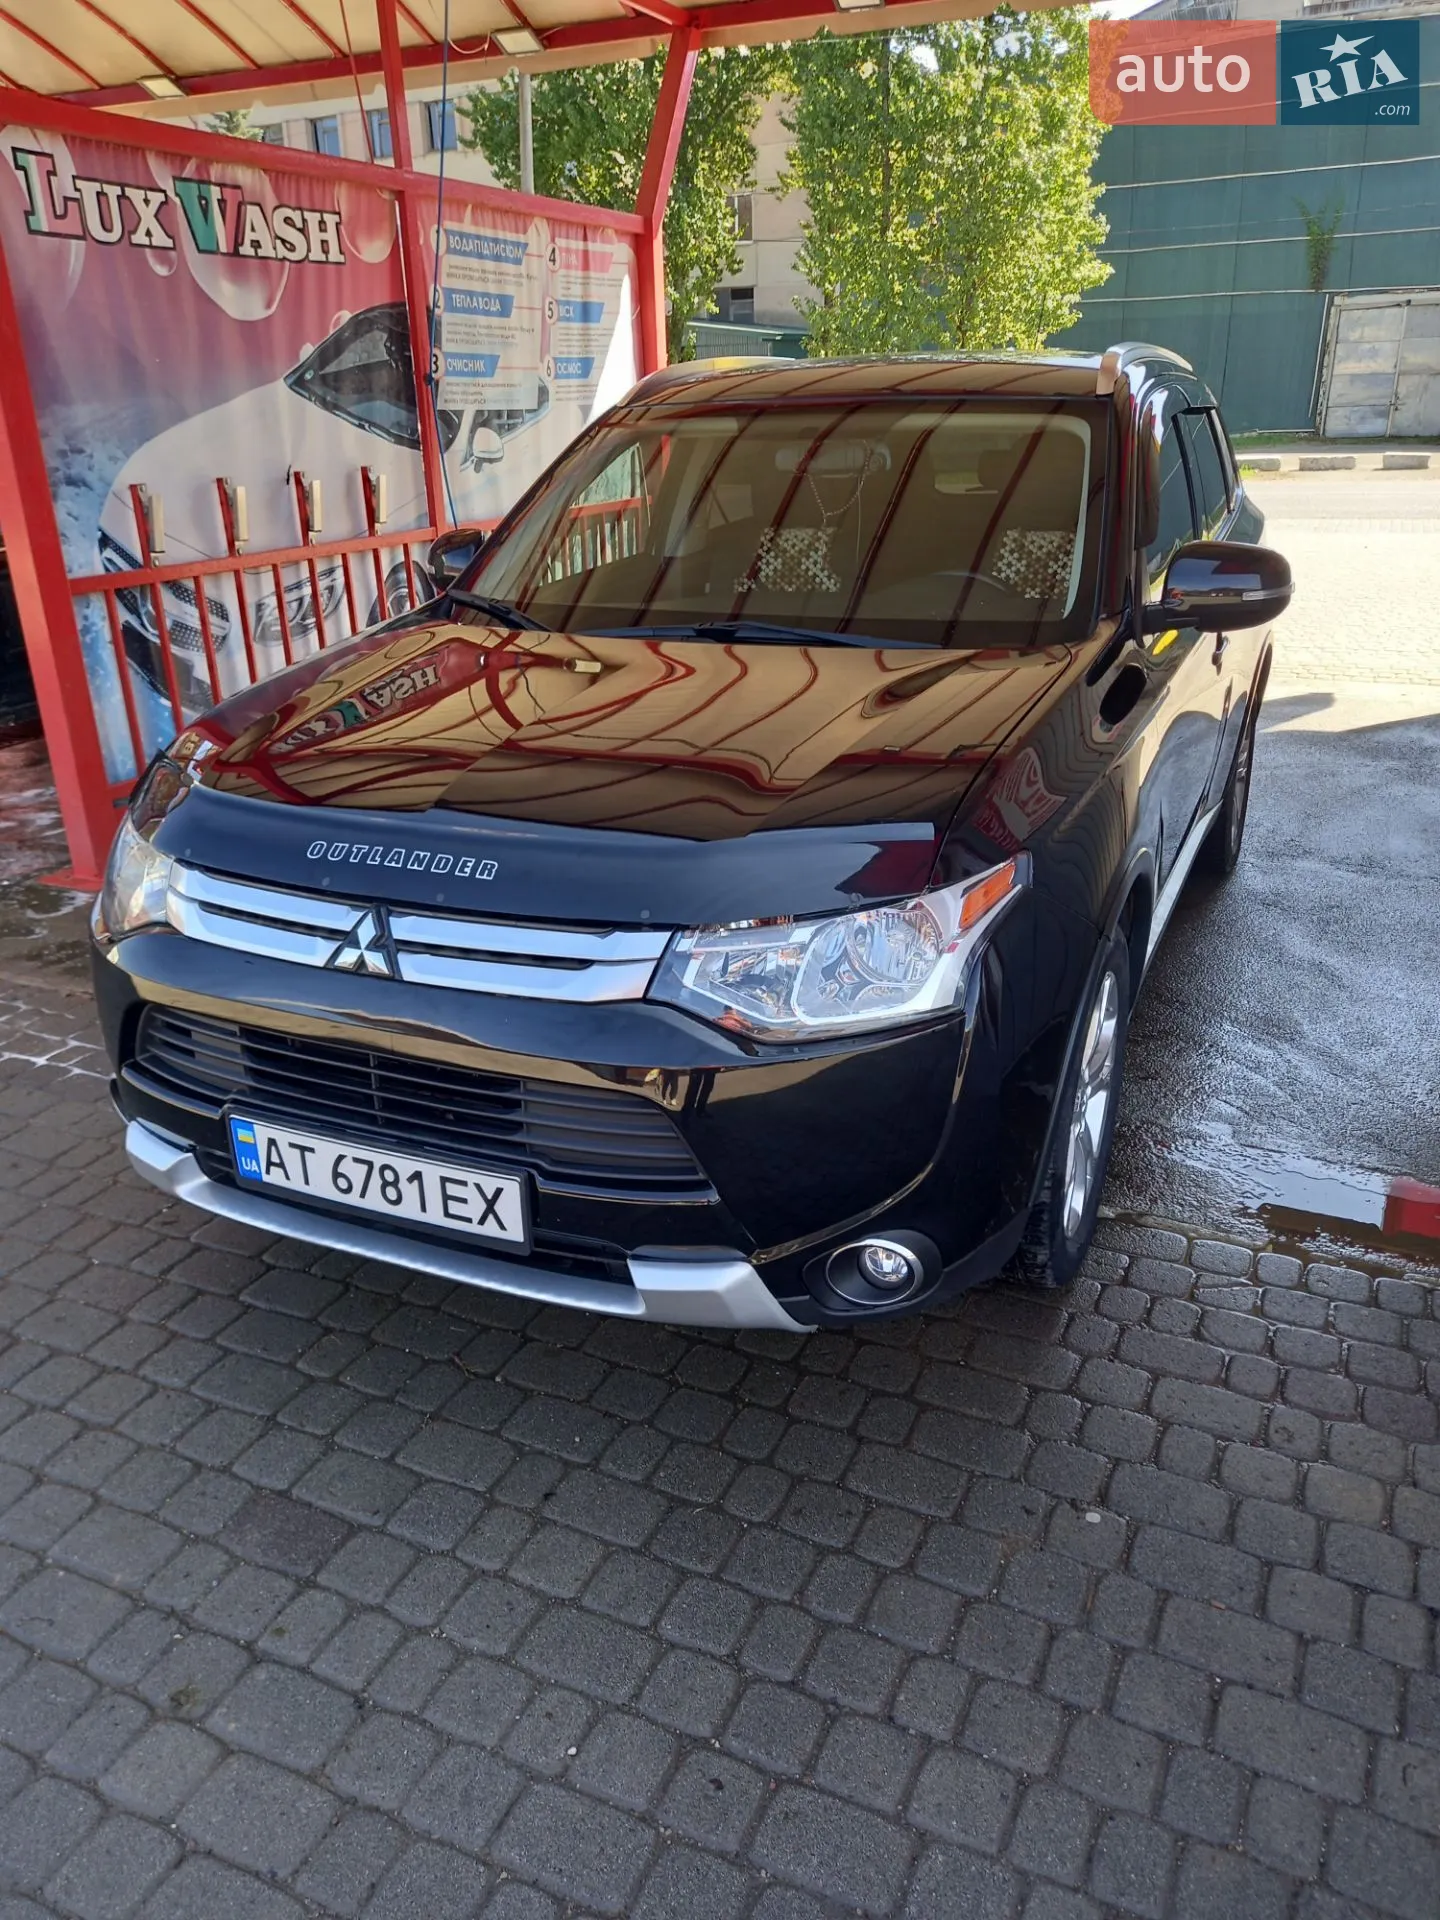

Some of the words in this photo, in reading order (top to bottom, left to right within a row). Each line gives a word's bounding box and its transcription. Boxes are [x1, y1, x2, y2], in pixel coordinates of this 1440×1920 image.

[548, 246, 557, 266] 4
[547, 301, 554, 319] 5
[432, 354, 439, 374] 3
[446, 358, 486, 373] ОЧИСНИК
[546, 360, 552, 377] 6
[306, 840, 499, 880] OUTLANDER
[241, 1155, 260, 1174] UA
[264, 1136, 315, 1186] AT
[331, 1153, 427, 1213] 6781
[439, 1175, 507, 1231] EX
